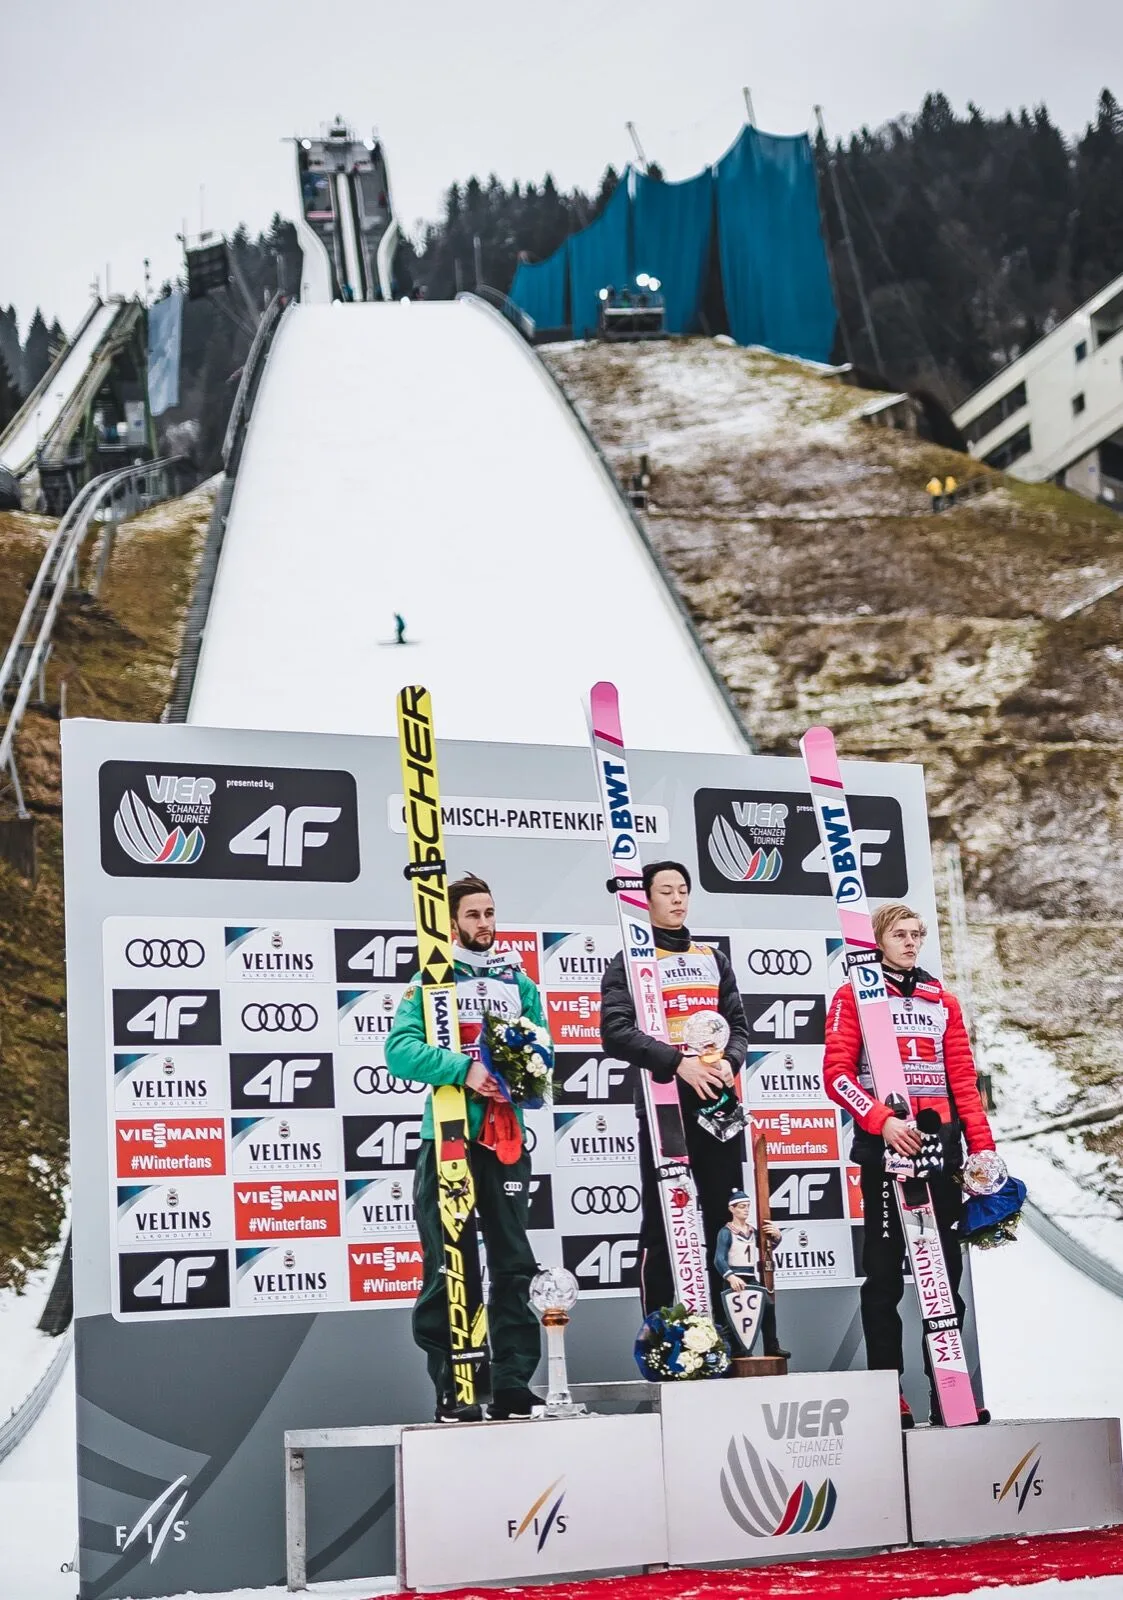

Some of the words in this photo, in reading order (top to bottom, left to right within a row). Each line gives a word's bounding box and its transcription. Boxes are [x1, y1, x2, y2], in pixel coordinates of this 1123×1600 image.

[145, 775, 216, 805] VIER
[226, 778, 262, 789] presented
[264, 780, 274, 790] by
[603, 761, 633, 830] BWT
[166, 804, 212, 815] SCHANZEN
[170, 813, 209, 824] TOURNEE
[401, 685, 448, 943] FISCHER
[731, 801, 789, 828] VIER
[229, 805, 342, 867] 4F
[749, 827, 786, 837] SCHANZEN
[753, 836, 785, 846] TOURNEE
[821, 806, 857, 873] BWT
[242, 953, 314, 970] VELTINS
[348, 936, 418, 978] 4F
[486, 957, 505, 965] uvex
[631, 948, 655, 957] BWT
[857, 953, 876, 962] BWT
[665, 968, 702, 978] VELTINS
[859, 988, 885, 1000] BWT
[549, 996, 601, 1018] VIESSM
[833, 998, 842, 1032] RENAULT
[126, 995, 208, 1040] 4F
[354, 1016, 394, 1032] VELT
[753, 1000, 816, 1039] 4F
[892, 1013, 933, 1026] ELTINS
[561, 1024, 601, 1037] #Winte
[906, 1038, 922, 1060] 1
[243, 1059, 321, 1103] 4F
[563, 1058, 631, 1098] 4F
[760, 1075, 821, 1090] VELTINS
[132, 1080, 208, 1098] VELTINS
[843, 1087, 870, 1112] LOTOS
[753, 1113, 835, 1135] VIESSMANN
[119, 1123, 223, 1148] VIESSMANN
[356, 1121, 423, 1164] 4F
[570, 1136, 635, 1154] VELTINS
[249, 1143, 322, 1161] VELTINS
[131, 1155, 212, 1170] #Winterfans
[237, 1185, 337, 1211] VIESSMANN
[769, 1173, 831, 1215] 4F
[362, 1204, 416, 1223] VELTI
[882, 1181, 890, 1238] POLSKA
[136, 1211, 211, 1231] VELTINS
[249, 1217, 327, 1232] #Winterfans
[352, 1246, 423, 1271] VIESSMA
[575, 1240, 639, 1283] 4F
[744, 1244, 751, 1263] 1
[775, 1250, 836, 1268] VELTINS
[133, 1255, 216, 1304] 4F
[254, 1272, 327, 1293] VELTINS
[363, 1278, 423, 1293] #Winterfa
[732, 1295, 743, 1313] S
[746, 1294, 757, 1310] C
[742, 1318, 752, 1333] P
[938, 1317, 958, 1329] BWT
[761, 1398, 849, 1441] VIER
[785, 1438, 844, 1455] SCHANZEN
[791, 1453, 841, 1469] TOURNEE
